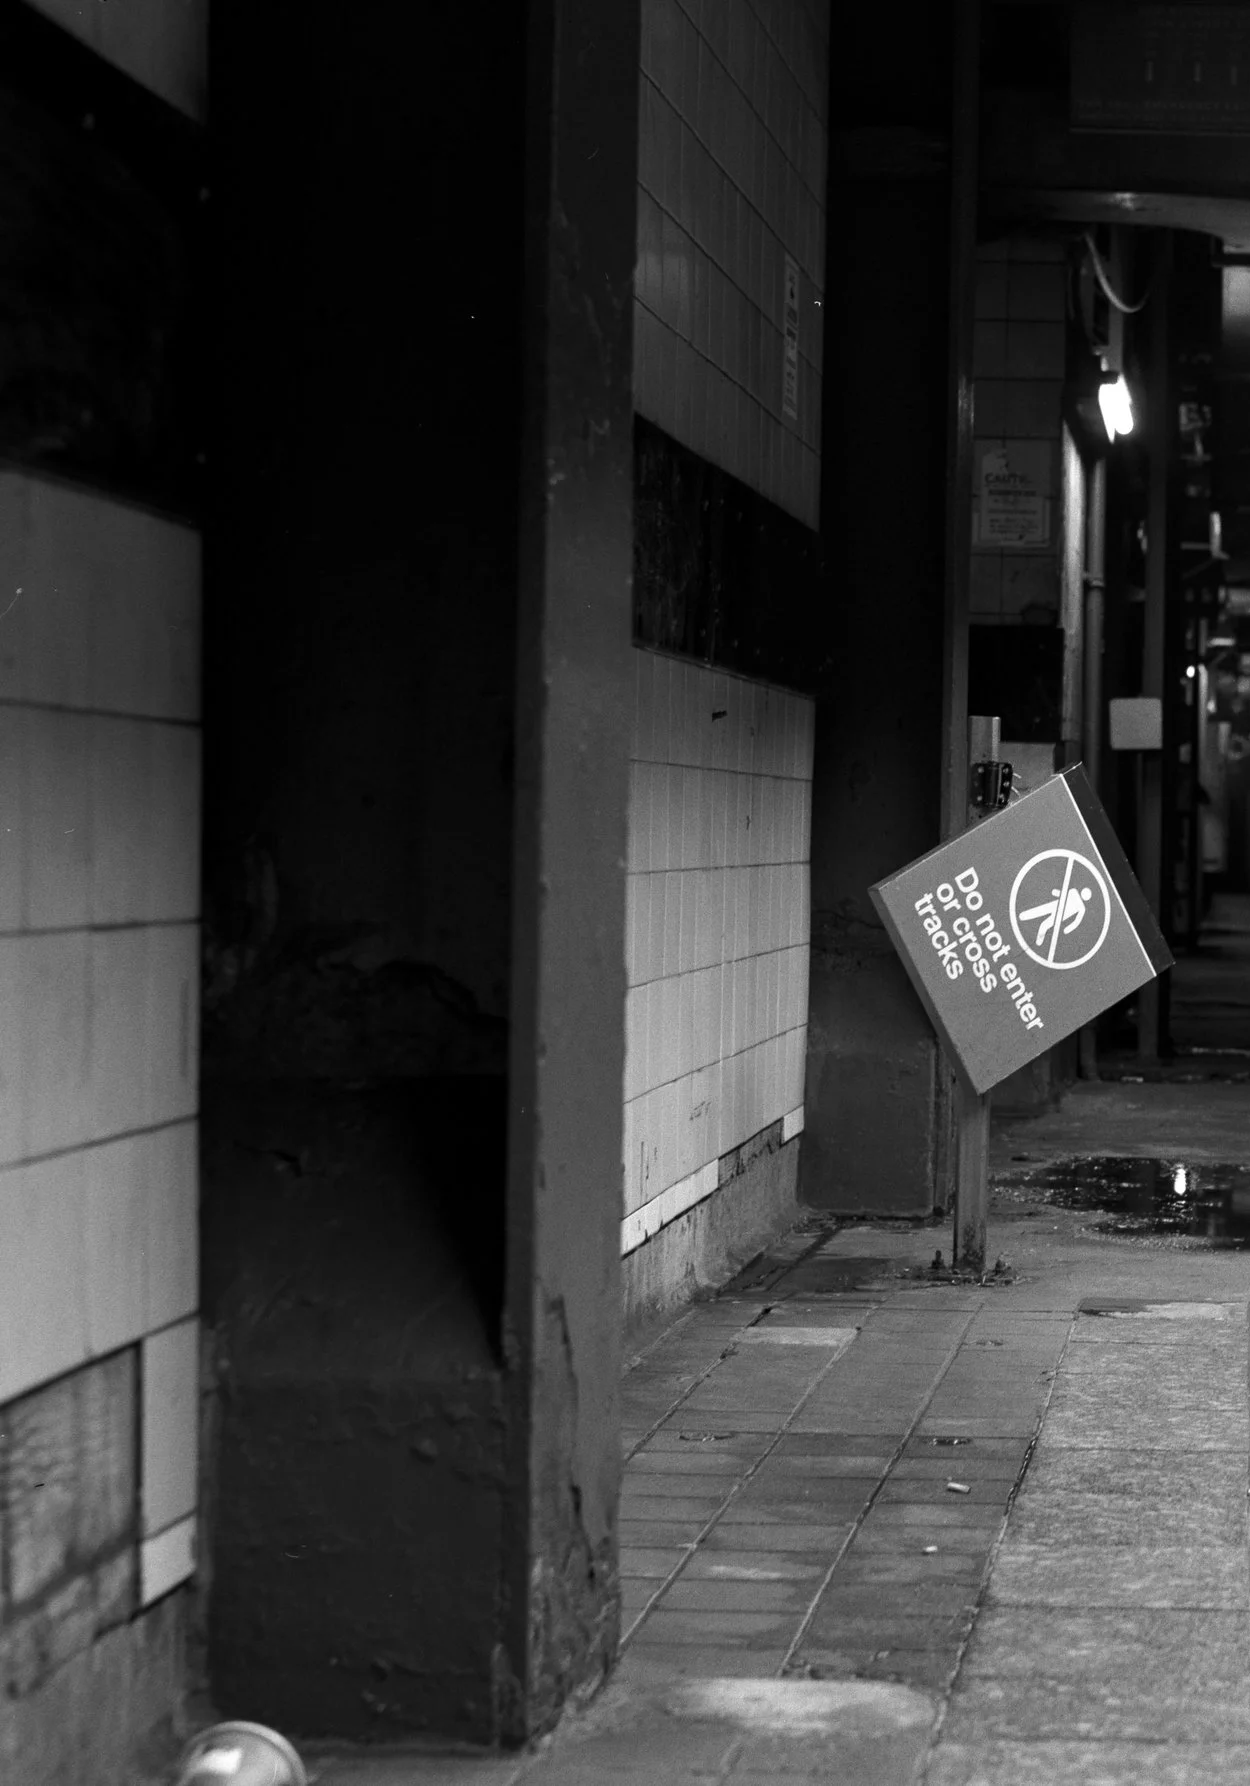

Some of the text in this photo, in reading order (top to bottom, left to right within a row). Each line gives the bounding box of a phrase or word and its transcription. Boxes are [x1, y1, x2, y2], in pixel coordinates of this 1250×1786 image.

[914, 893, 963, 980] tracks
[936, 883, 997, 993] or cross
[954, 866, 1044, 1030] Do not enter
